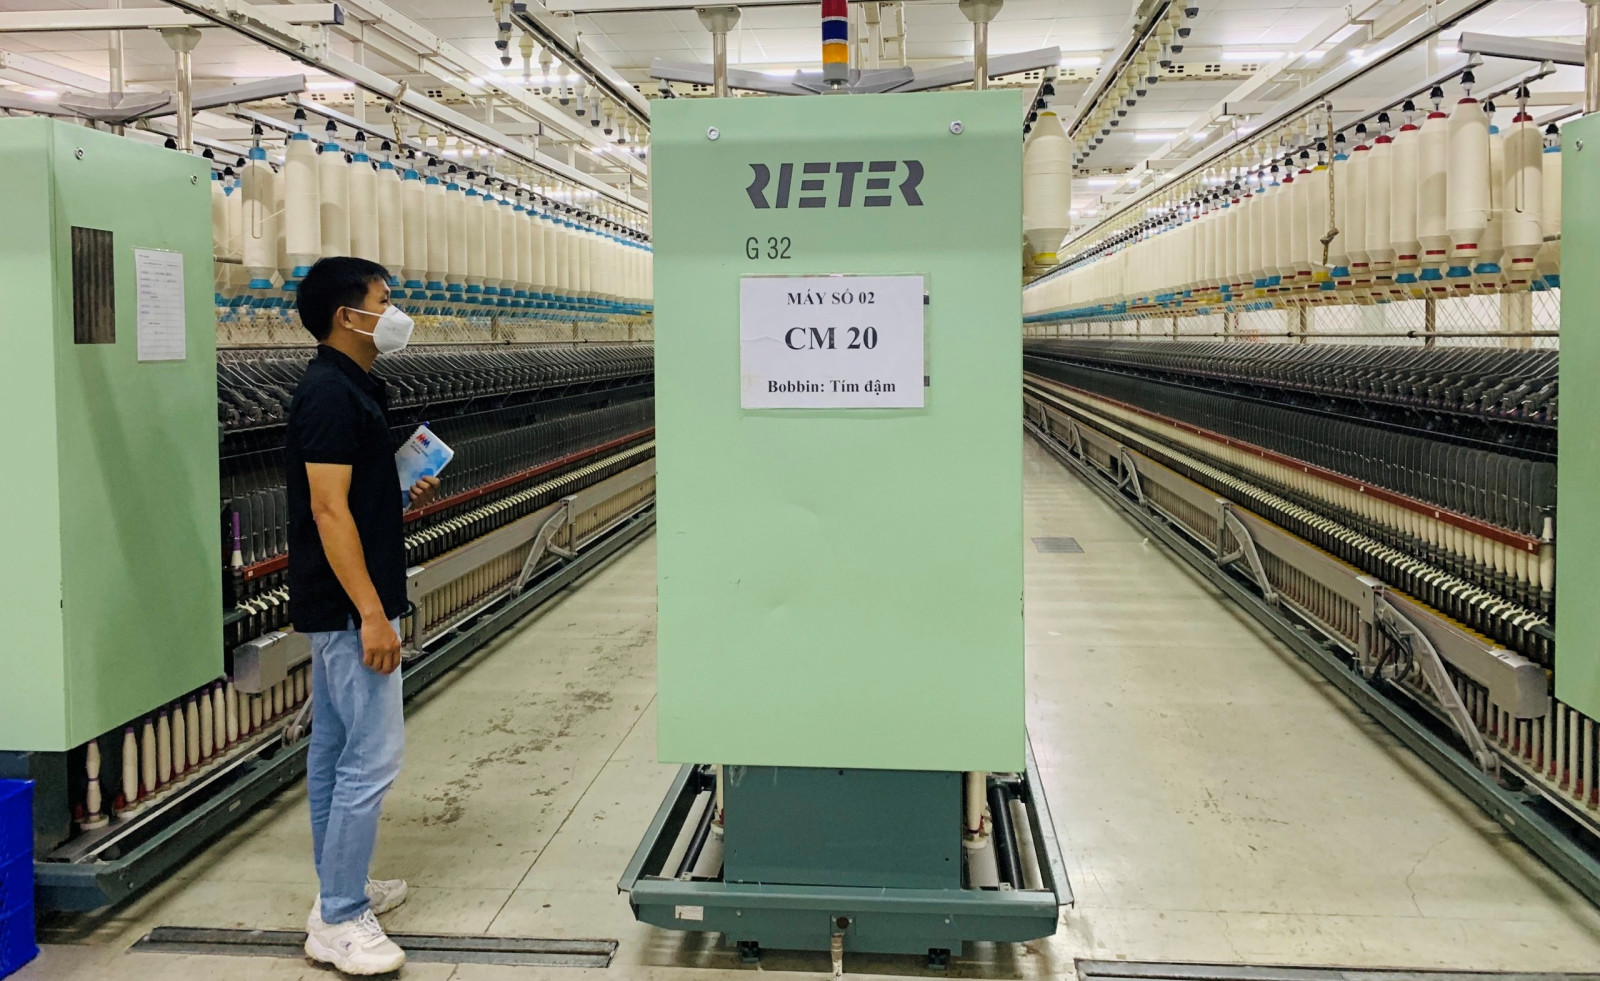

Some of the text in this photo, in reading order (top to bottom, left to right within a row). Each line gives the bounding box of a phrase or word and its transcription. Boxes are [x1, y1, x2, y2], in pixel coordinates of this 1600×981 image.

[745, 160, 925, 209] RIETER
[745, 236, 791, 260] G 32
[787, 288, 827, 305] MÁY
[858, 291, 875, 305] 02
[784, 326, 878, 350] CM 20
[768, 379, 896, 396] Bobbin: Tím đậm
